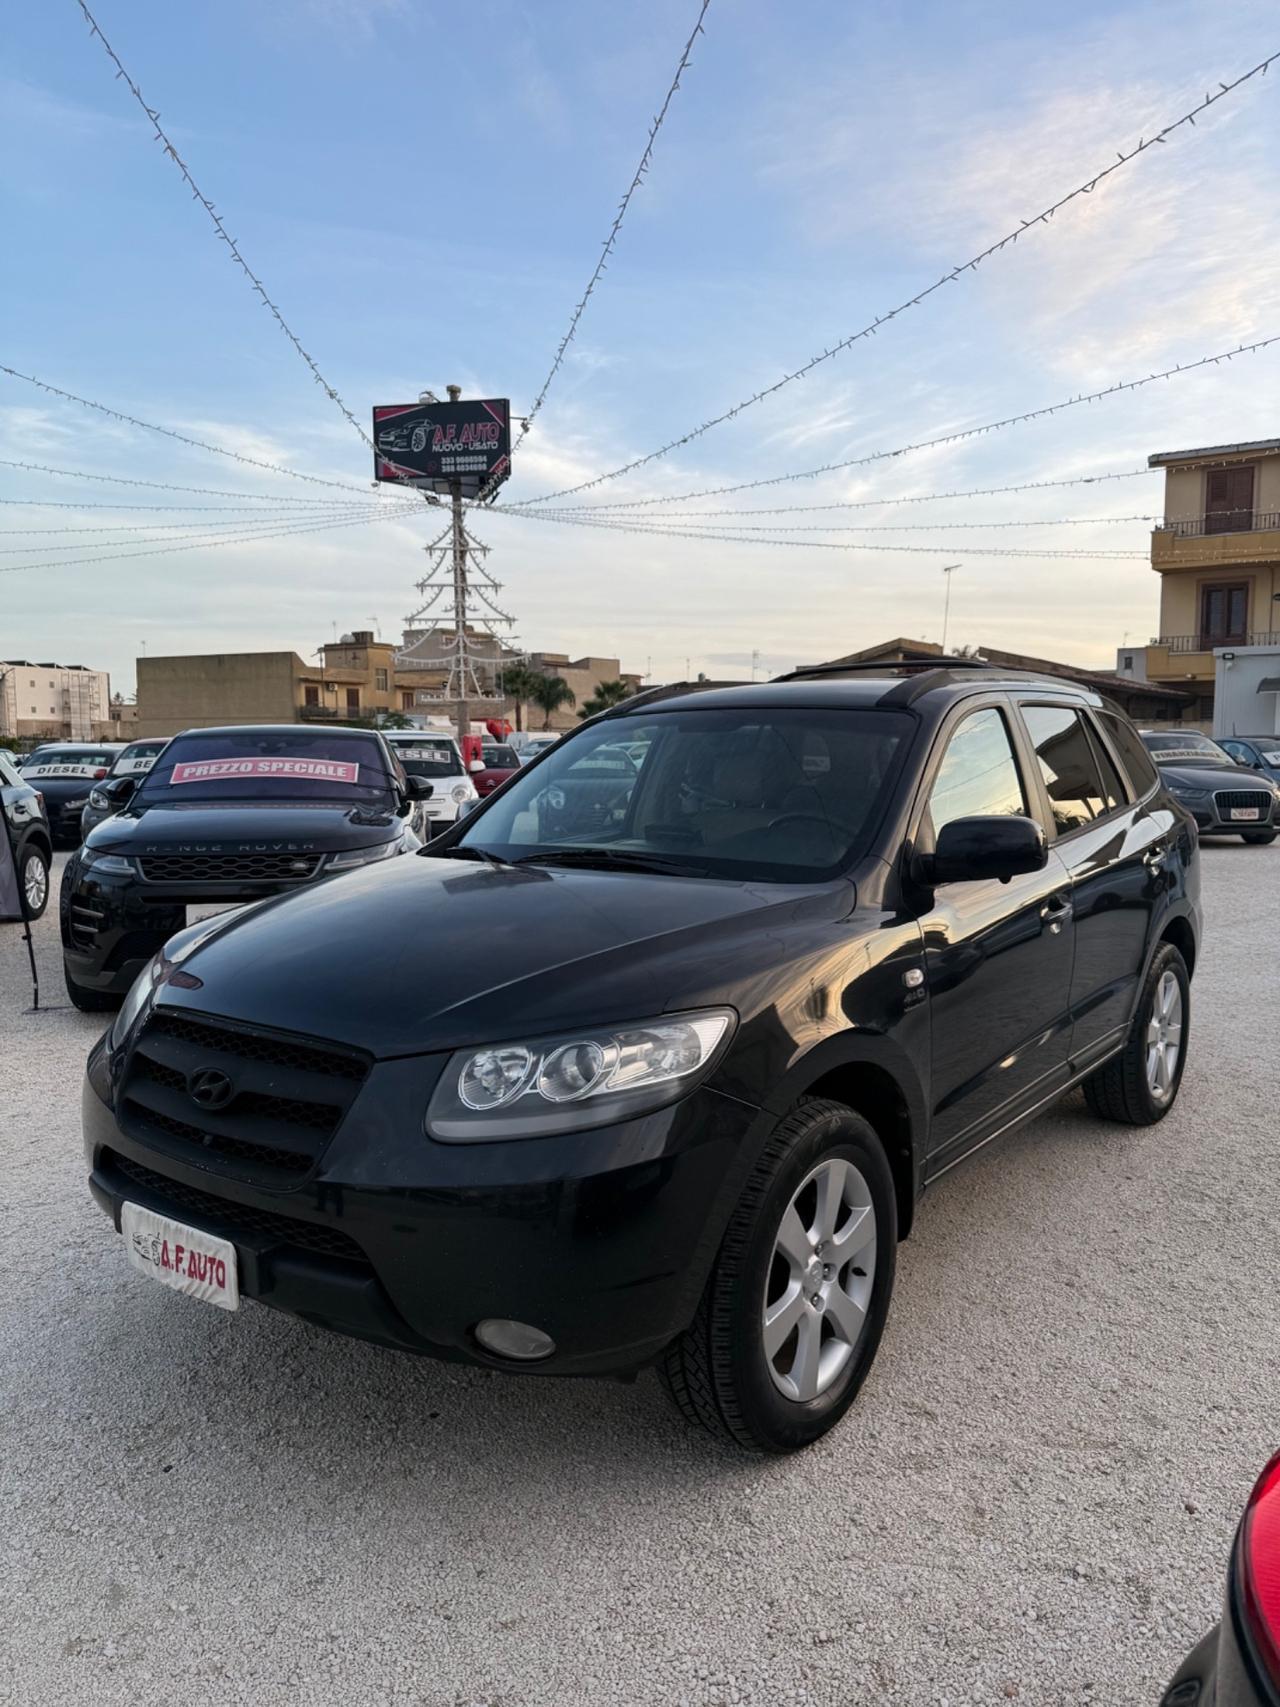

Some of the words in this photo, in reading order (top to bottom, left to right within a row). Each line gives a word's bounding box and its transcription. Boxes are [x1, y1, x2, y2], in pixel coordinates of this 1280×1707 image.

[459, 421, 500, 443] AUTO
[432, 443, 463, 452] NUOVO
[468, 441, 498, 450] USATO
[37, 766, 88, 775] DIESEL
[183, 761, 255, 778] PREZZO
[257, 761, 347, 777] SPECIALE
